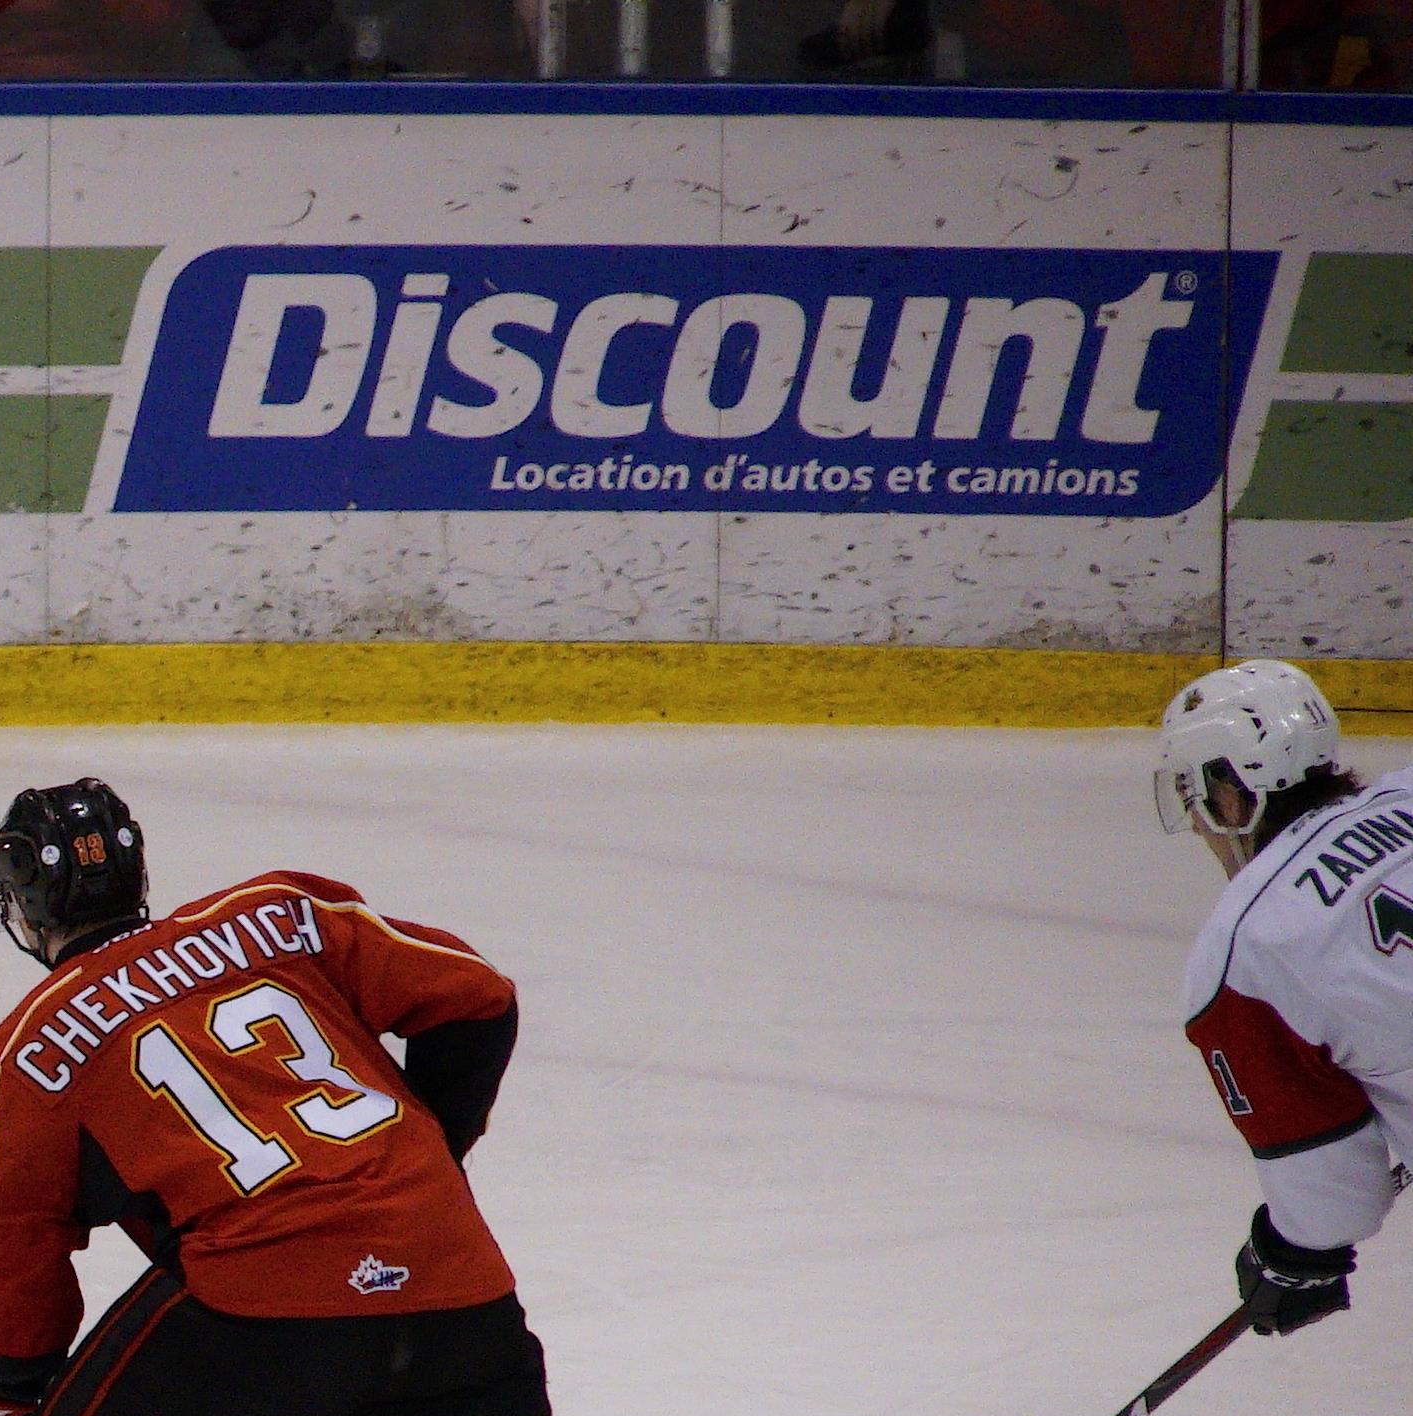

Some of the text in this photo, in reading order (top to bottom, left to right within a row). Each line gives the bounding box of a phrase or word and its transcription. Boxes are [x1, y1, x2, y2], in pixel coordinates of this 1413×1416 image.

[207, 271, 1195, 444] Discount
[490, 454, 1141, 496] Location d'autos et camions
[14, 898, 324, 1093] CHEKHOVICH
[131, 980, 404, 1197] 13
